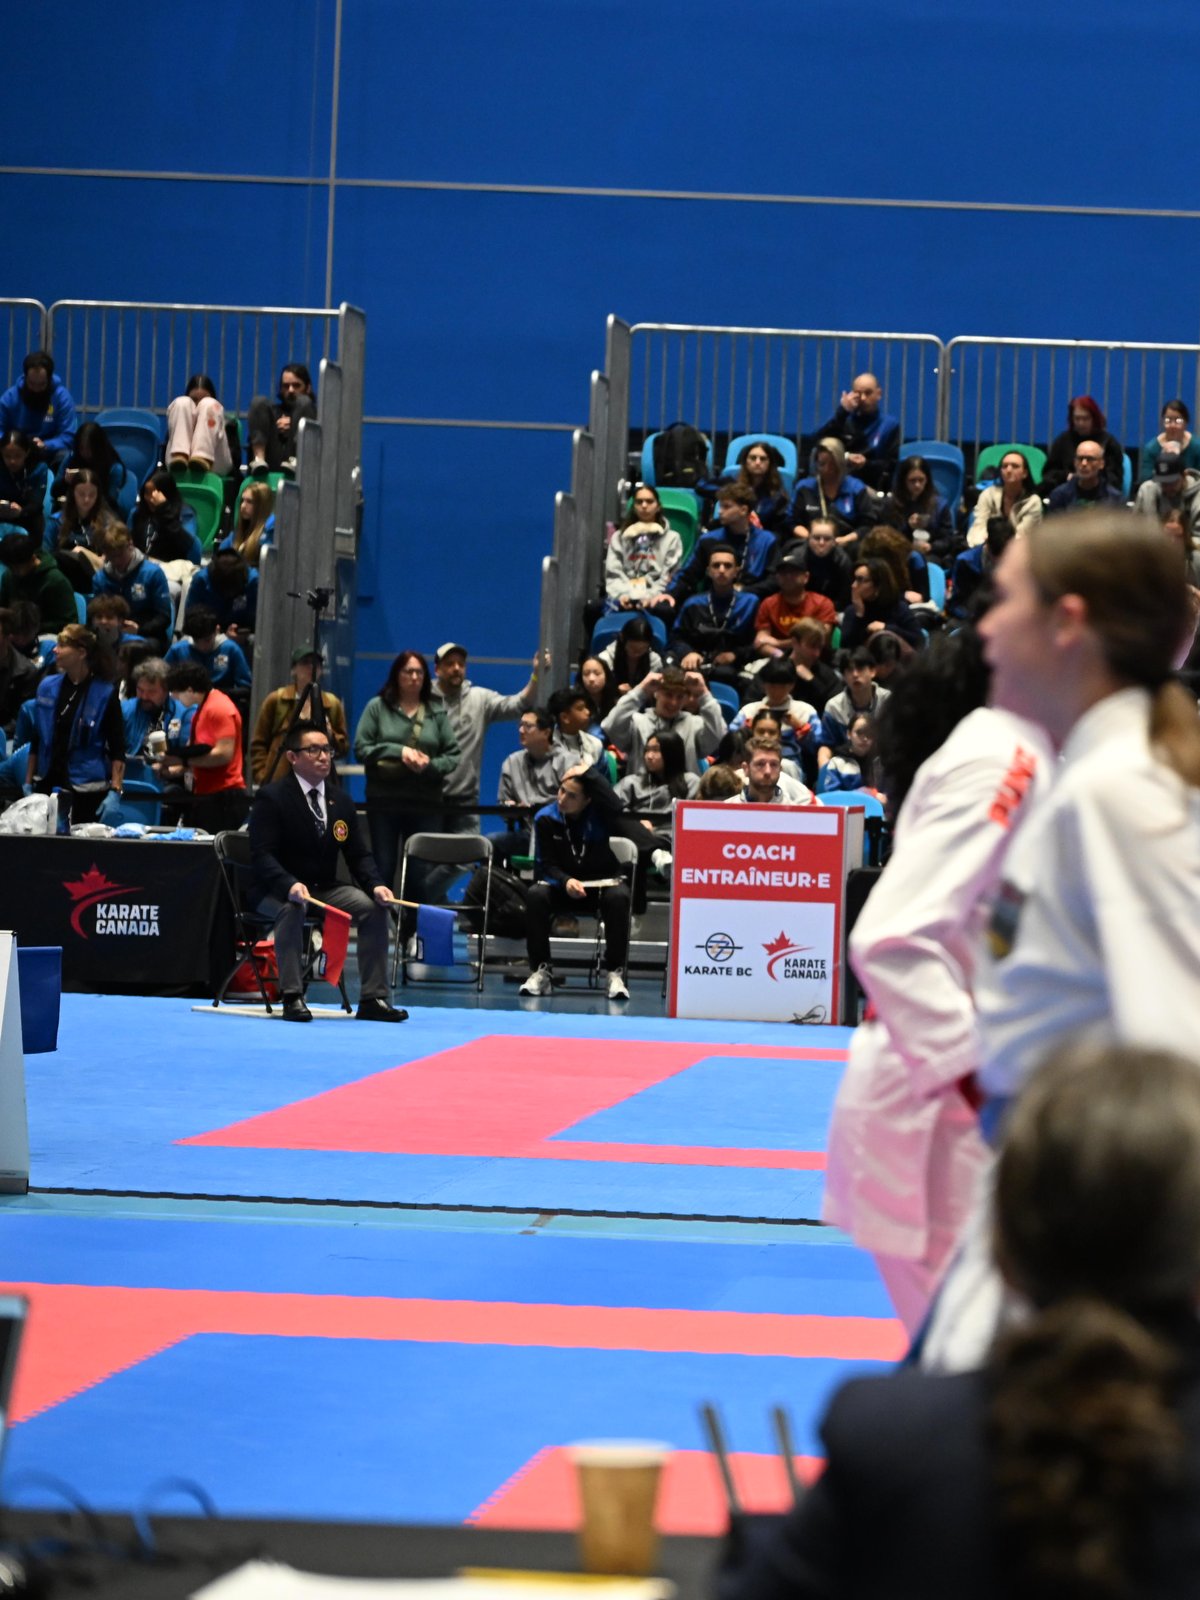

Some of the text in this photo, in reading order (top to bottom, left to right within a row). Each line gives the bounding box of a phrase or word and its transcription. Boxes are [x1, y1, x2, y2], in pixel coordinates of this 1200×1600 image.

[722, 843, 796, 861] COACH
[96, 903, 160, 920] KARATE
[95, 919, 160, 937] CANADA
[784, 958, 826, 969] KARATE
[684, 965, 753, 977] KARATE BC
[784, 969, 827, 980] CANADA
